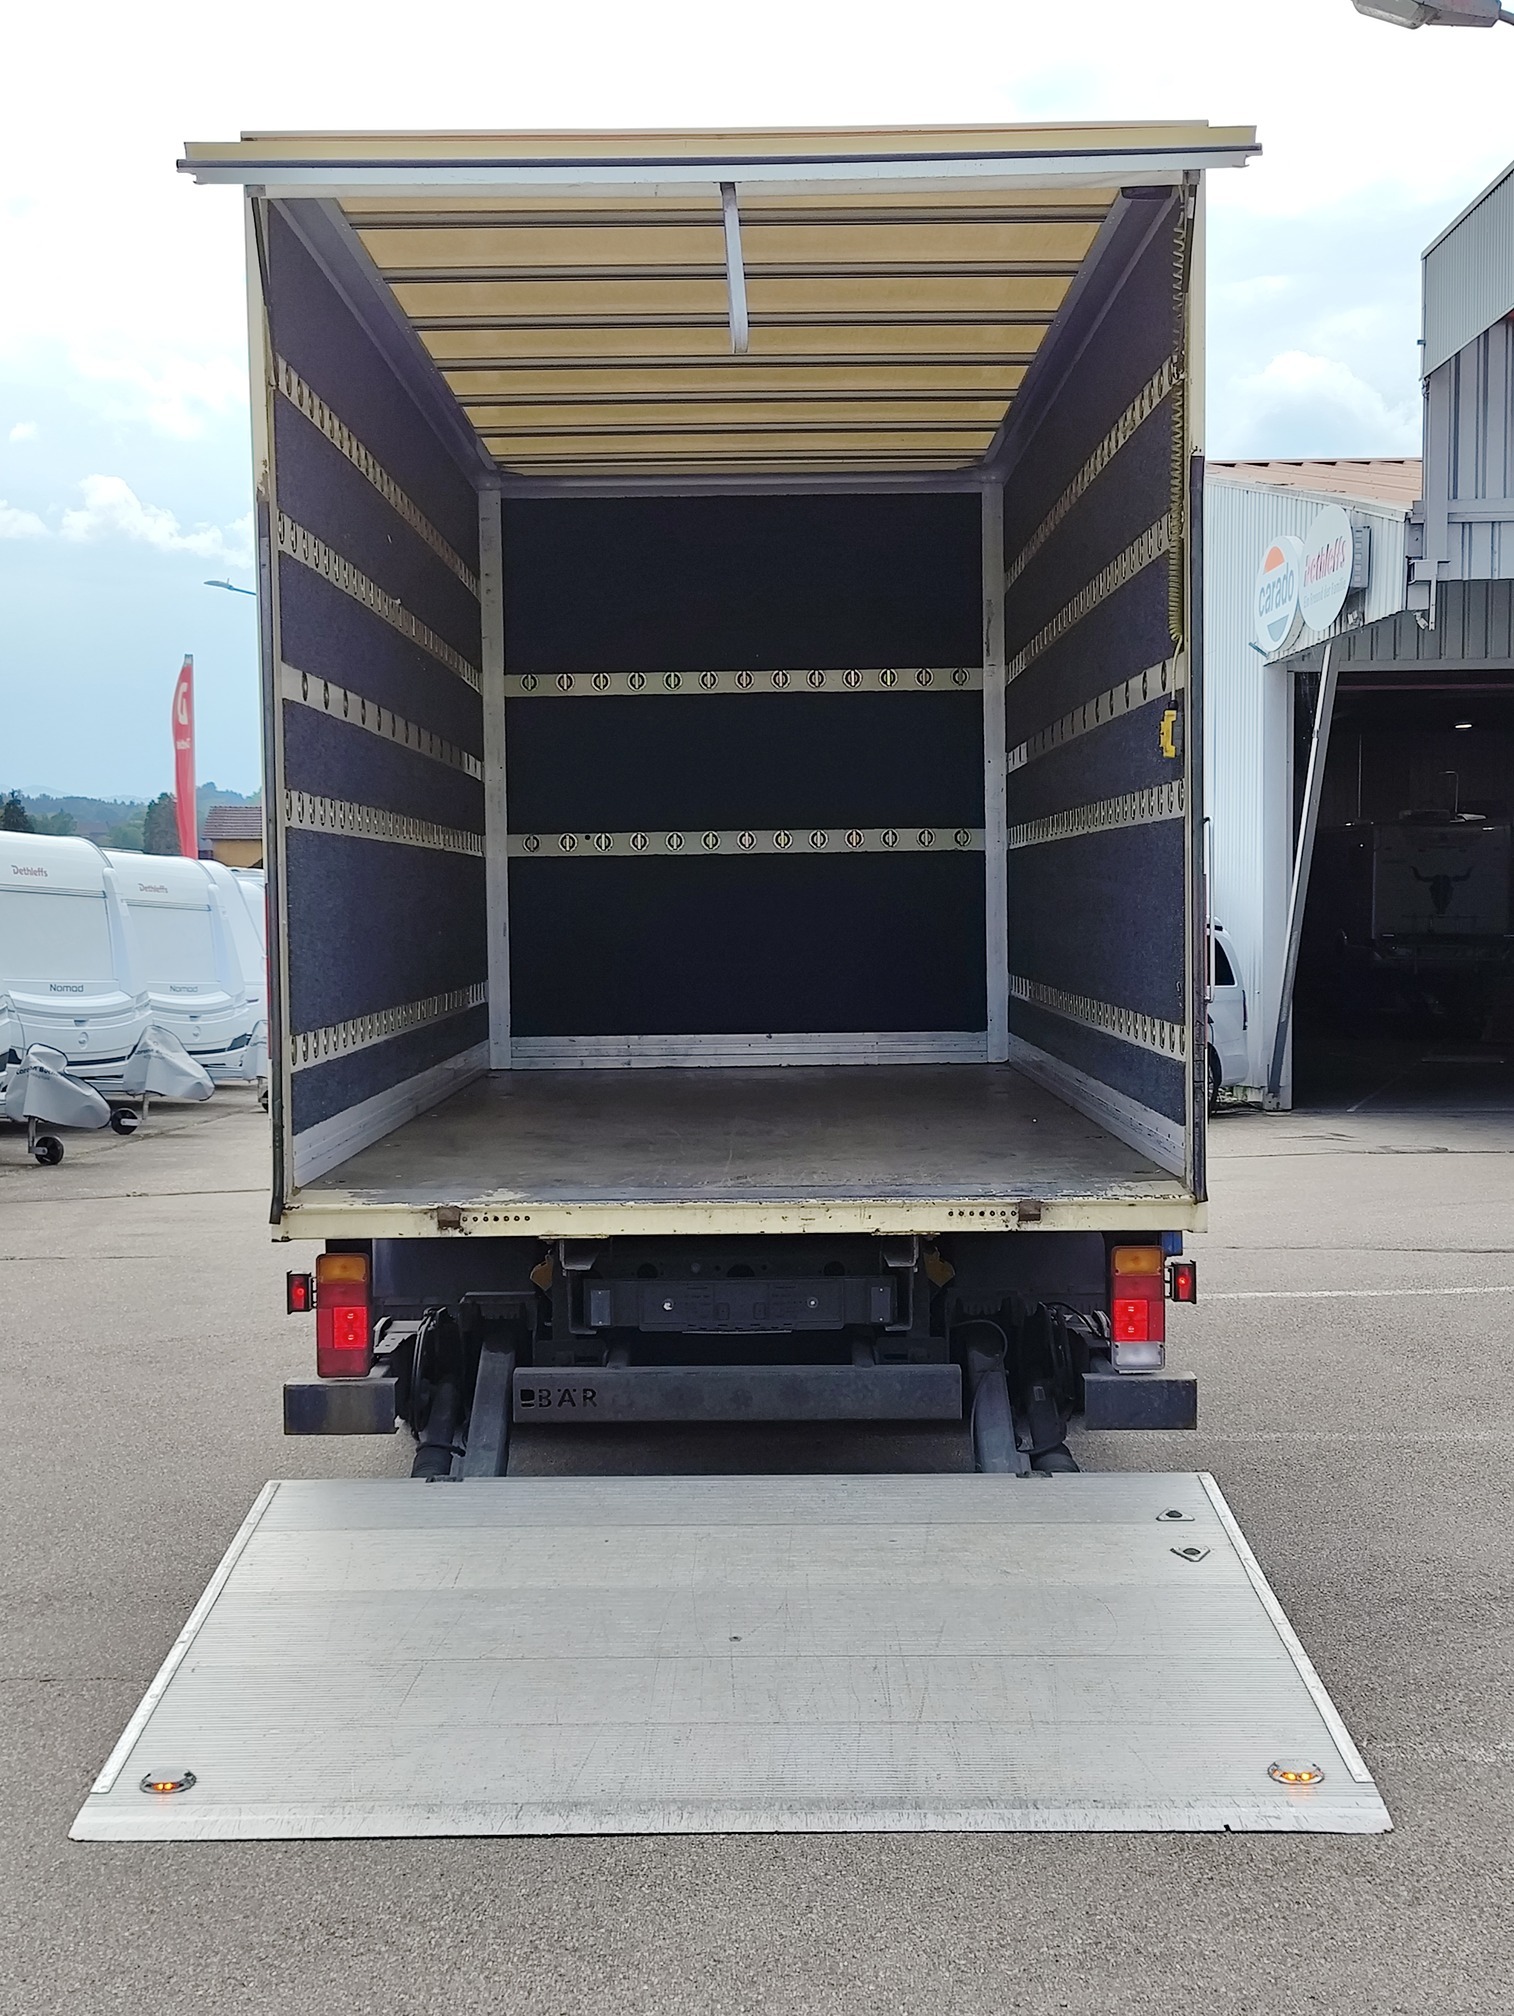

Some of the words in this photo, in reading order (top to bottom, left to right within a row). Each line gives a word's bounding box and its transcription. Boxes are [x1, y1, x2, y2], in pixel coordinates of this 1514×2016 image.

[1259, 562, 1294, 617] carado
[11, 864, 48, 877] Dethleffs
[138, 883, 168, 894] Dethleffs
[50, 983, 84, 993] Nomad
[169, 985, 198, 993] Nomad
